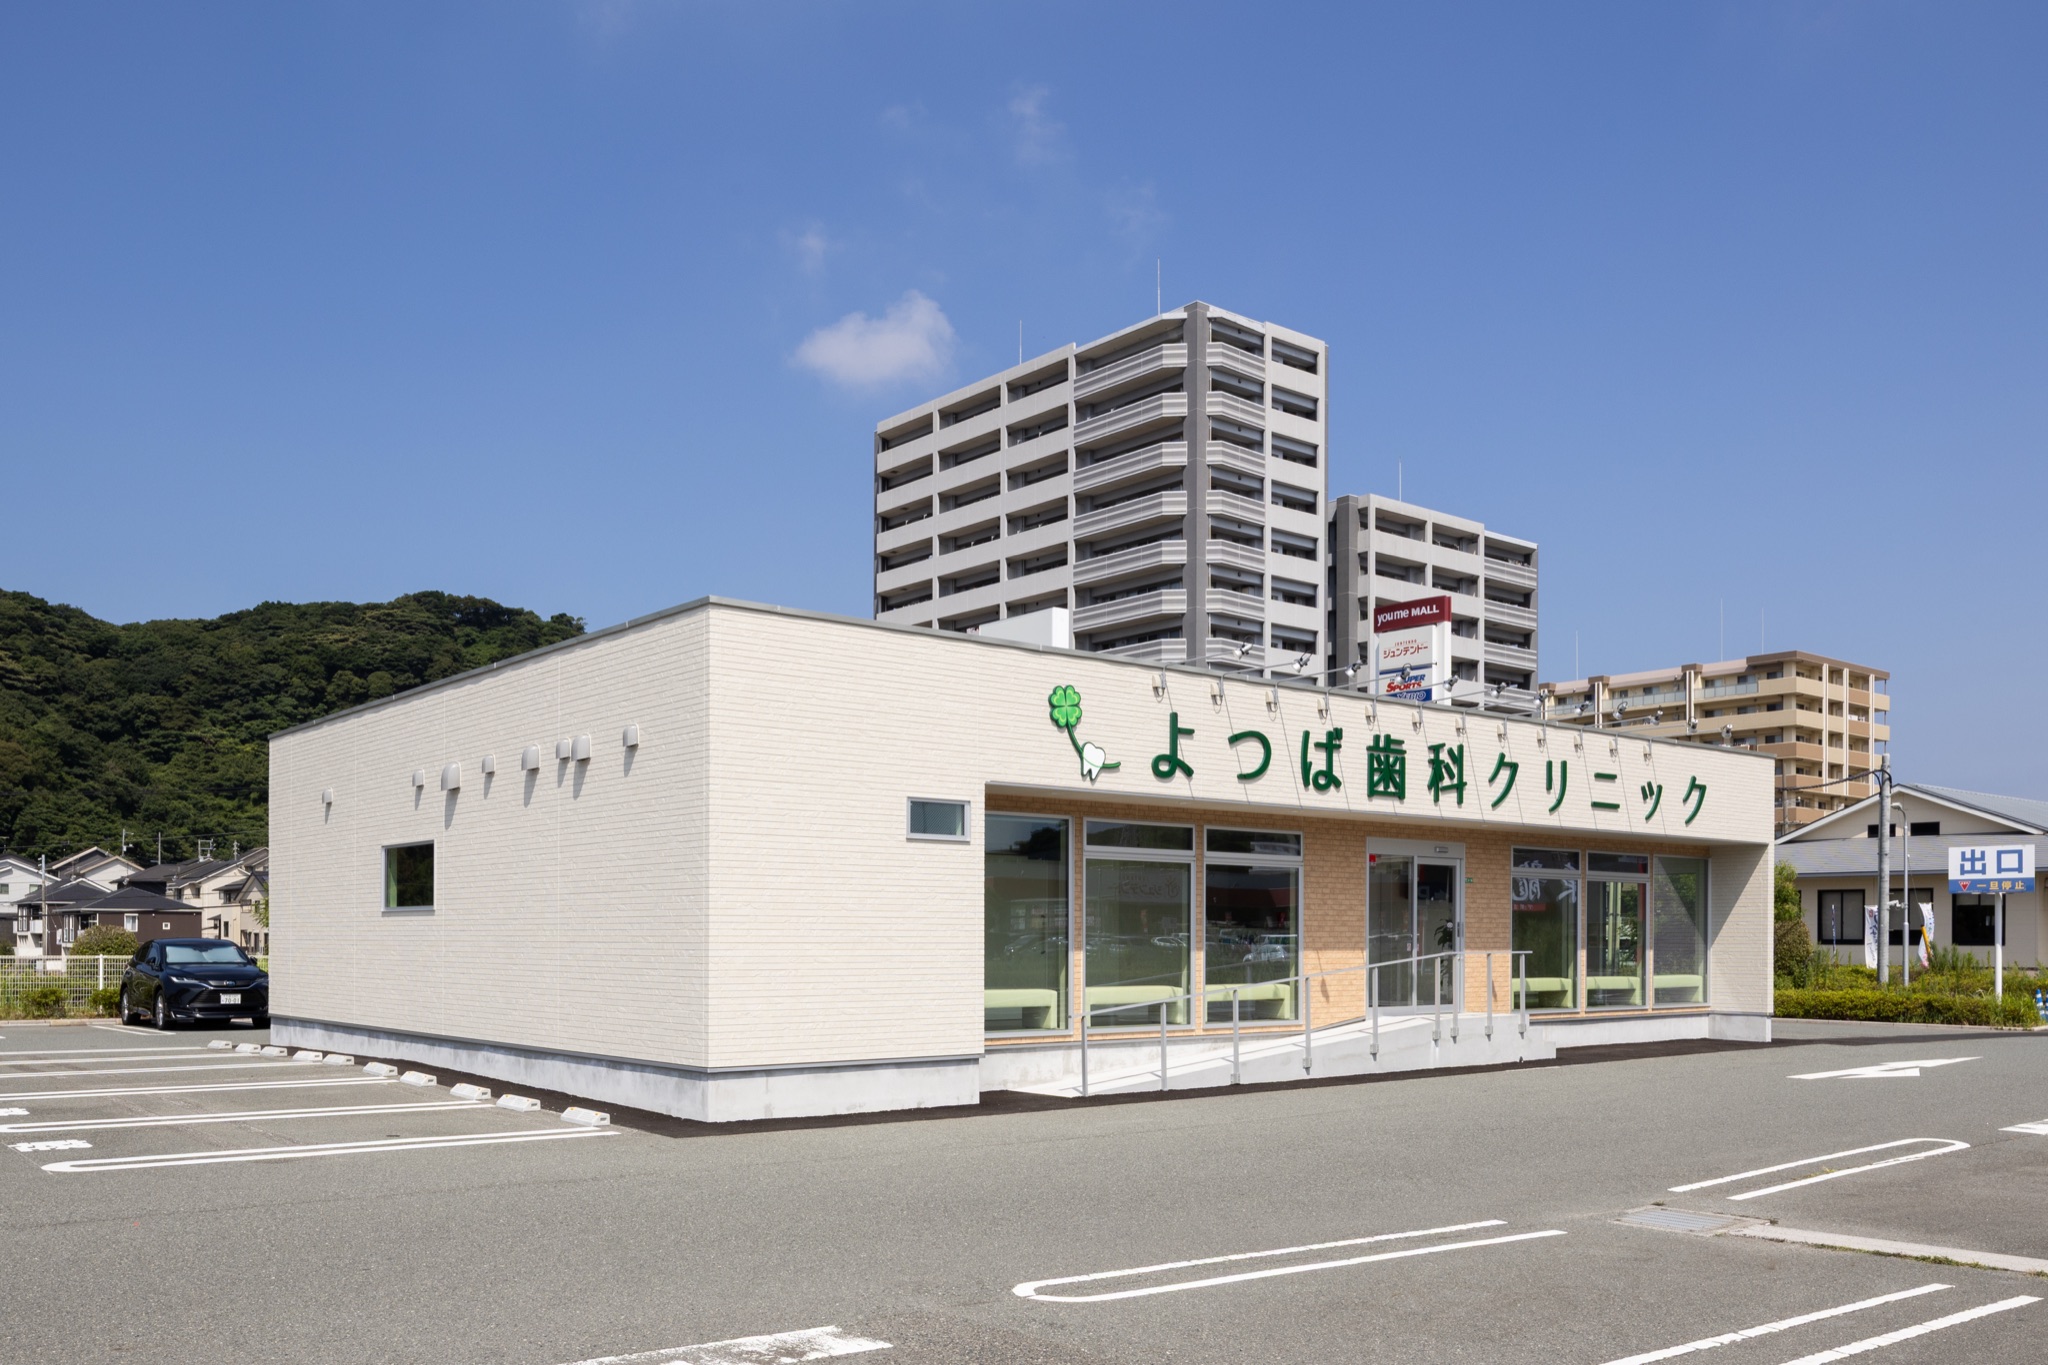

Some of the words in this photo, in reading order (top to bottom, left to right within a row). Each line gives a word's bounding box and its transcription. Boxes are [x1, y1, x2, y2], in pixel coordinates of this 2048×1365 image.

[1377, 609, 1409, 627] youme
[1411, 604, 1439, 617] MALL
[1383, 644, 1428, 659] ジュンテンドー
[1386, 681, 1422, 693] SPORTS
[1403, 674, 1425, 683] UPER
[1151, 711, 1708, 825] よつば歯科クリニック
[1960, 849, 2023, 876] 出口
